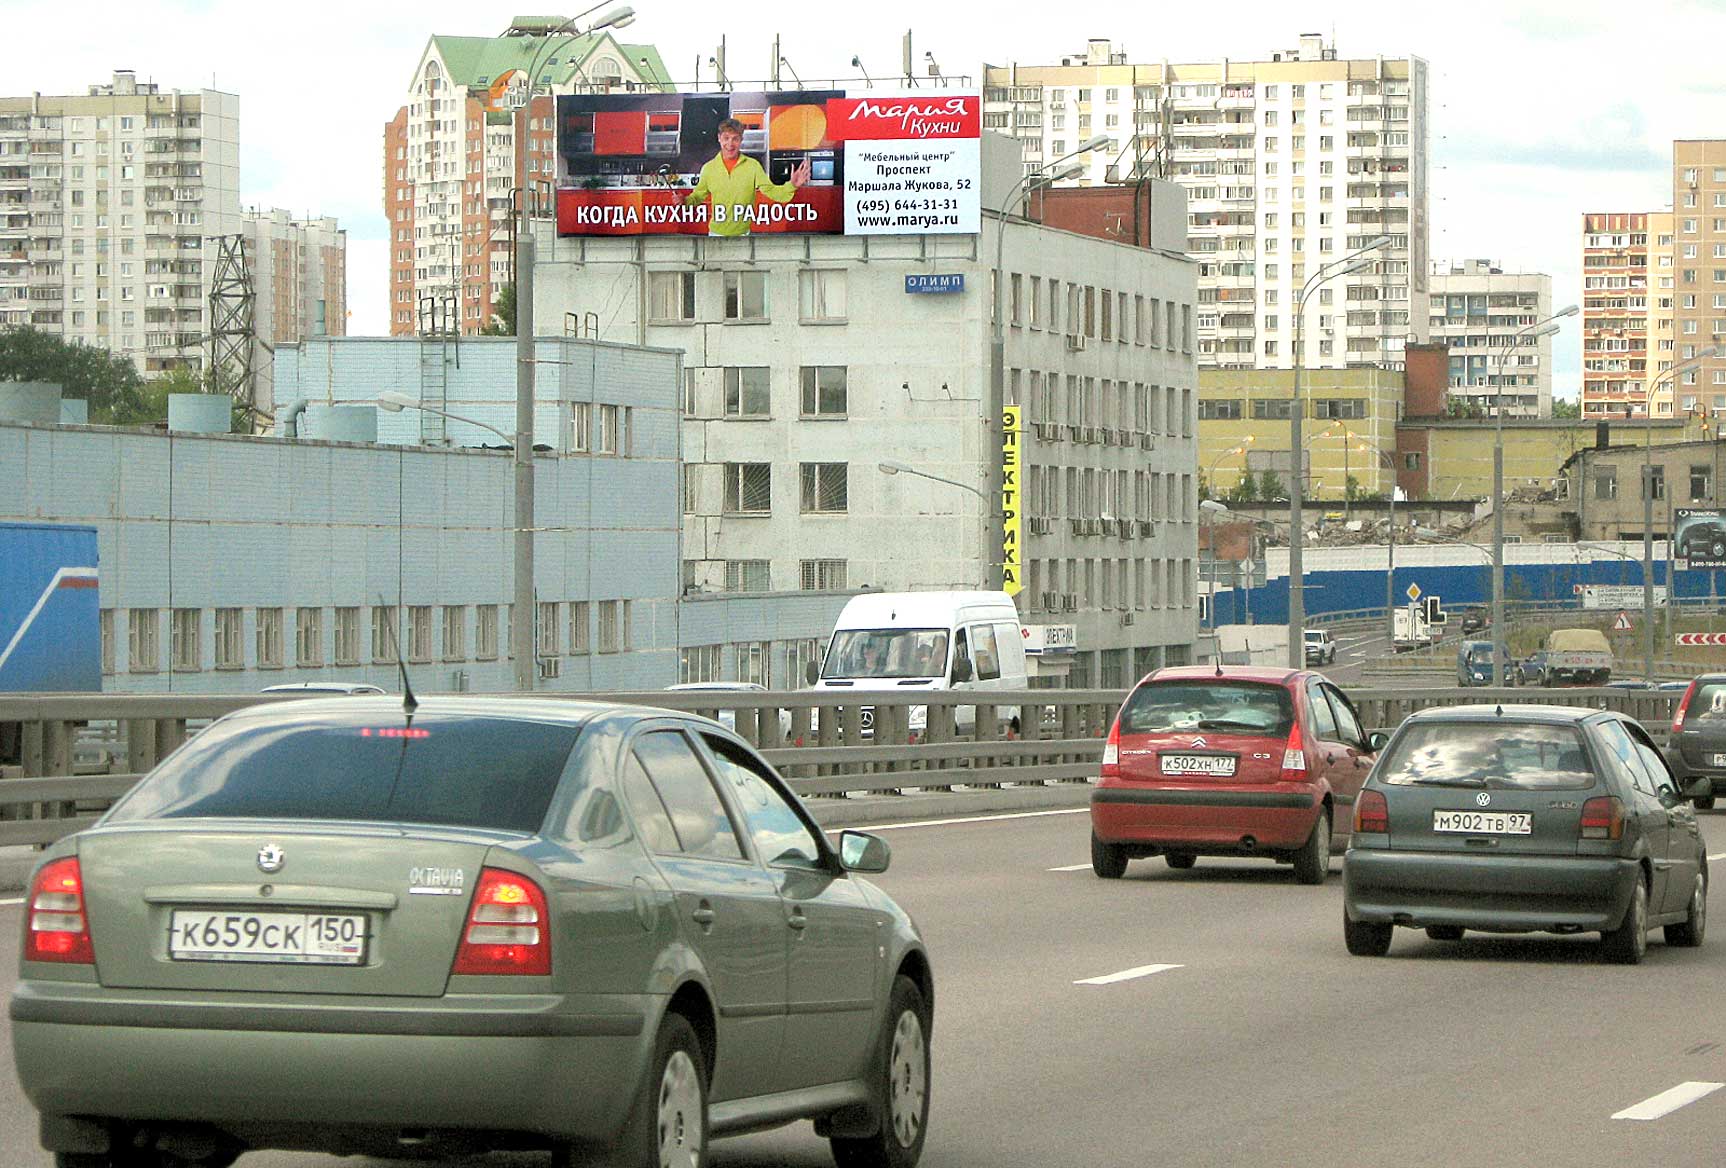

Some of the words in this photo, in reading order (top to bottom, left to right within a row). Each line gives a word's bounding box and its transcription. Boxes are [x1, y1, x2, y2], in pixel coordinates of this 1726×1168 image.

[910, 118, 961, 138] Кухни
[876, 164, 931, 178] Проспект
[848, 180, 901, 194] Маршала
[904, 179, 953, 193] Жукова,
[956, 178, 972, 190] 52
[856, 199, 890, 214] (495)
[894, 199, 958, 211] 644-31-31
[577, 205, 639, 227] КОГДА
[644, 204, 707, 224] КУХНЯ
[714, 204, 726, 222] В
[733, 203, 818, 226] РАДОСТЬ
[857, 214, 959, 229] www.marya.ru
[907, 276, 961, 287] ОЛИМП
[1003, 412, 1016, 584] ЭЛЕКТРИКА
[1165, 757, 1212, 770] К502ХН
[1215, 758, 1232, 768] 177
[1440, 814, 1504, 831] М902ТВ
[1509, 815, 1526, 827] 97
[410, 867, 464, 887] OCTAVIA
[182, 916, 300, 949] К659СК
[311, 917, 355, 942] 150
